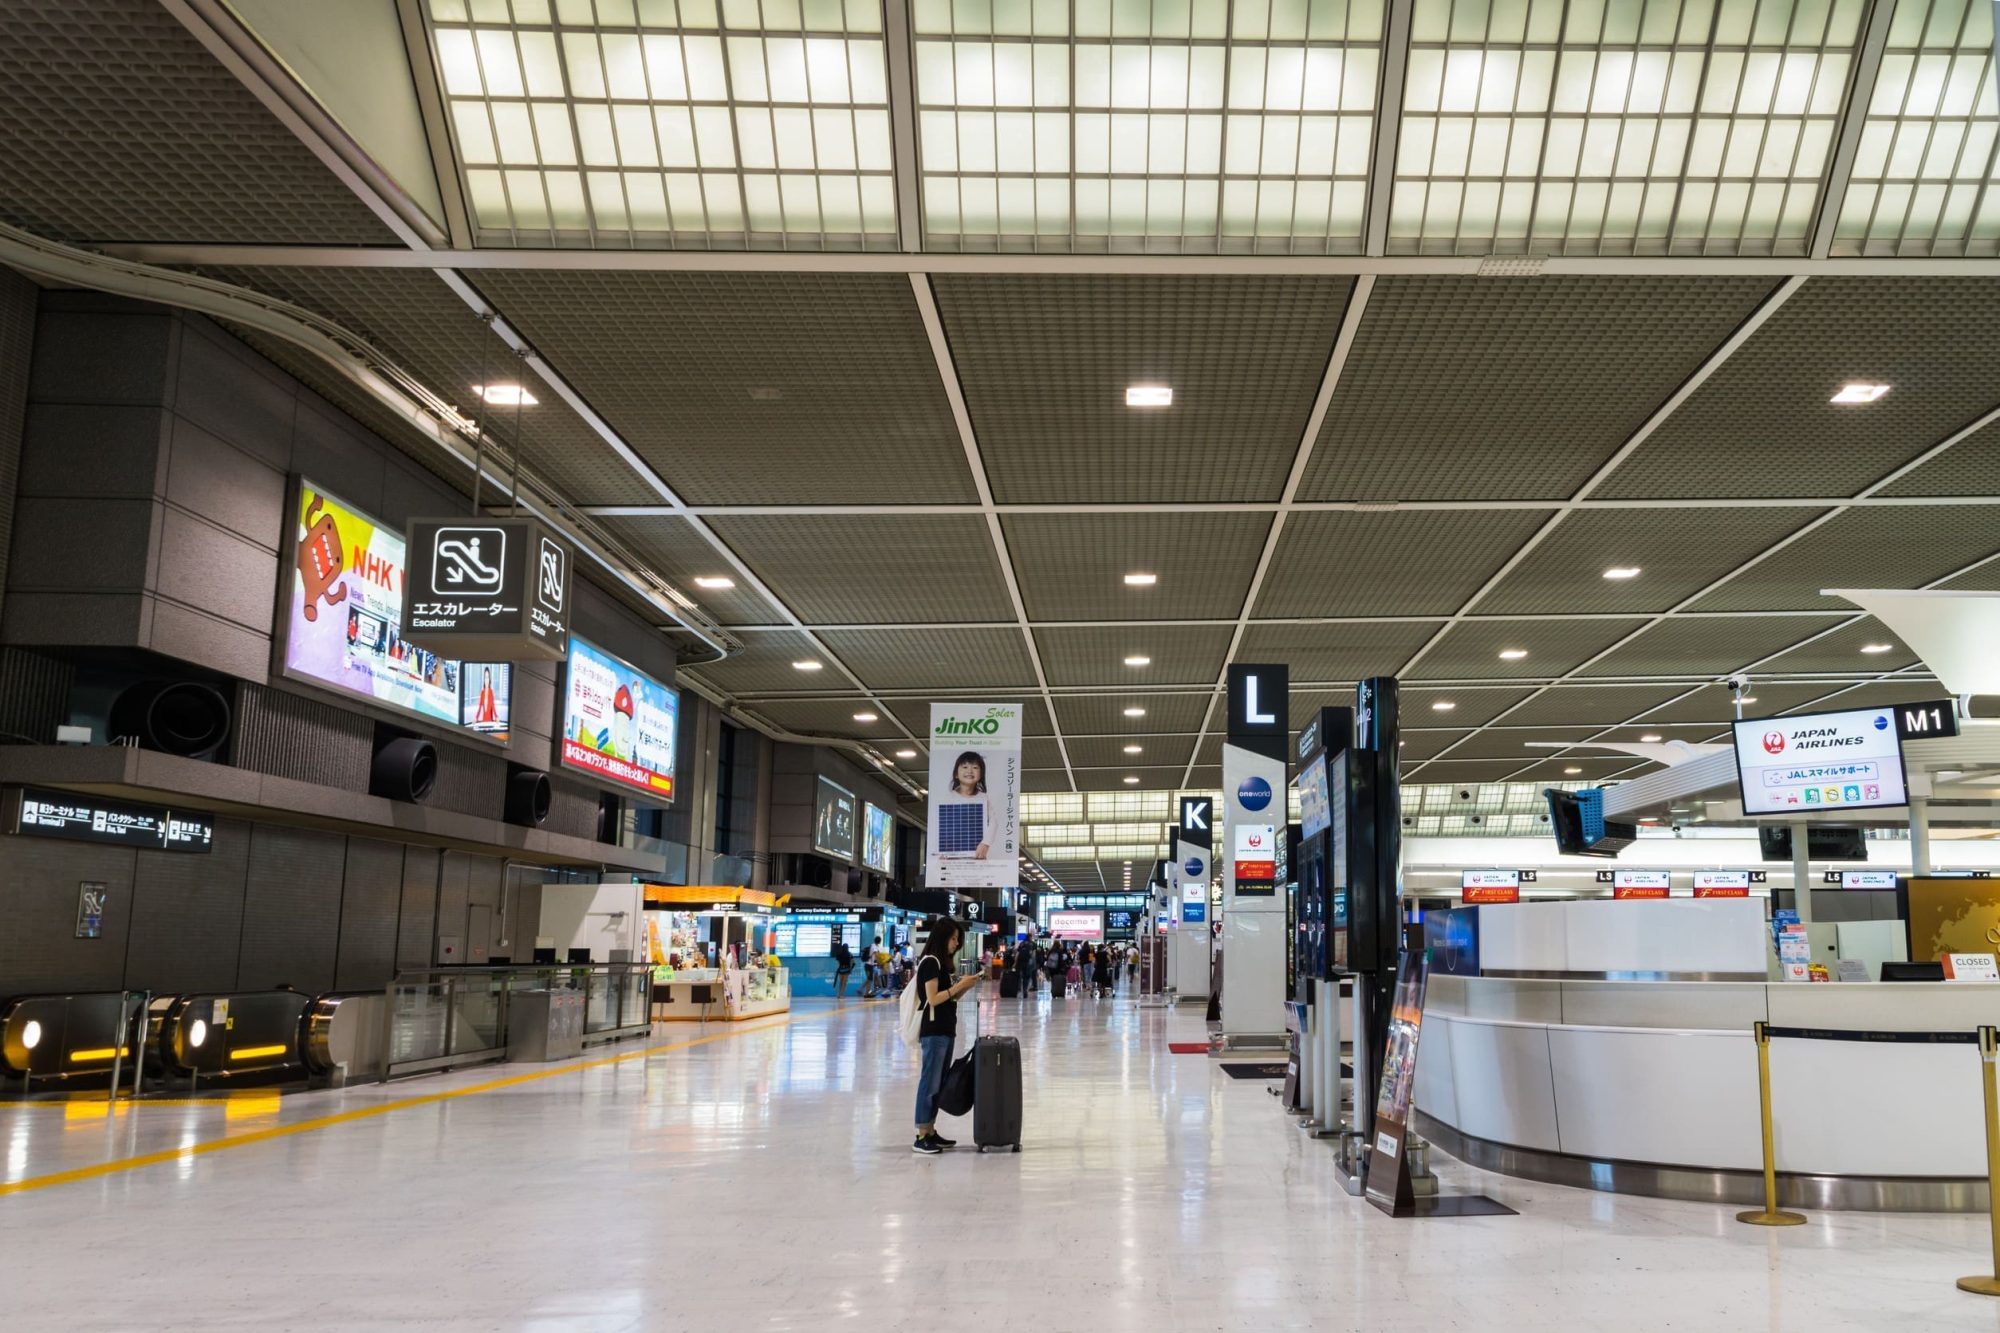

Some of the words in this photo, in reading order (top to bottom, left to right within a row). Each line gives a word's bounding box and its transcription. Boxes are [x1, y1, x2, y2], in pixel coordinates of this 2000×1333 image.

[352, 544, 393, 591] NHK
[413, 603, 518, 616] エスカレーター
[412, 618, 456, 627] Escalator
[532, 608, 565, 632] エスカレーター
[1246, 676, 1275, 723] L
[986, 708, 1014, 718] Solar
[935, 716, 998, 734] JinKO
[1906, 709, 1942, 732] M1
[1792, 728, 1837, 740] JAPAN
[1796, 736, 1864, 750] AIRLINES
[1186, 802, 1208, 829] K
[1522, 872, 1534, 880] L2
[1020, 894, 1027, 906] F
